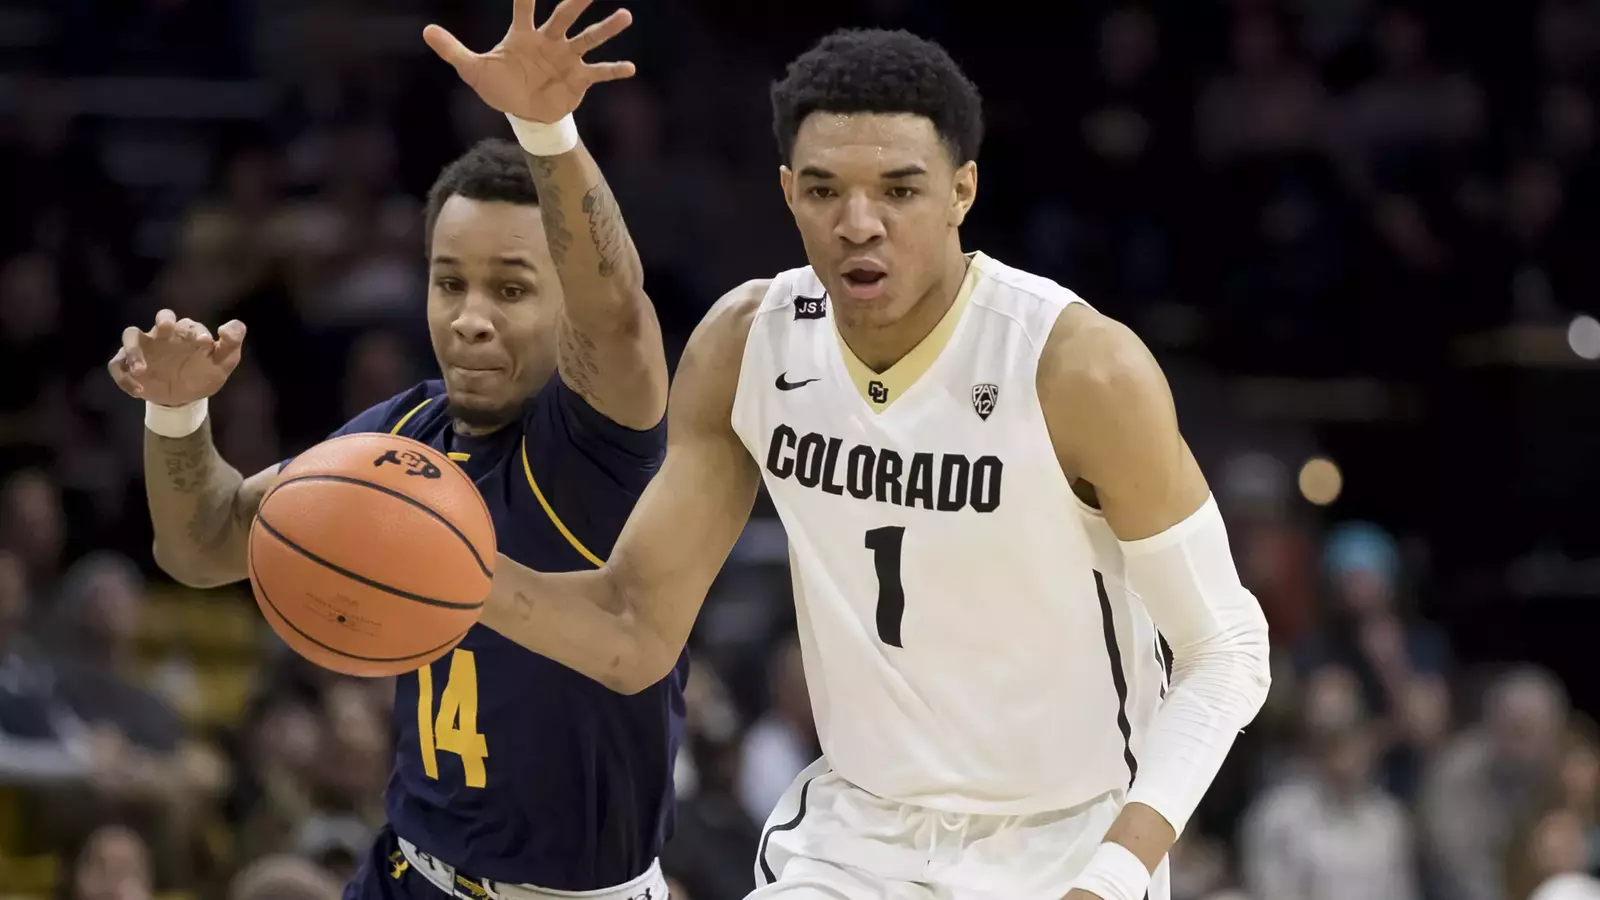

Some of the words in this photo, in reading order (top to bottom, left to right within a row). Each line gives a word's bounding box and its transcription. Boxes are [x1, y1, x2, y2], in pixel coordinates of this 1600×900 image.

[799, 302, 817, 313] JS
[868, 380, 889, 404] CU
[972, 384, 998, 406] PAC
[978, 399, 992, 414] 12
[767, 423, 1003, 513] COLORADO
[865, 525, 906, 649] 1
[417, 648, 489, 789] 14
